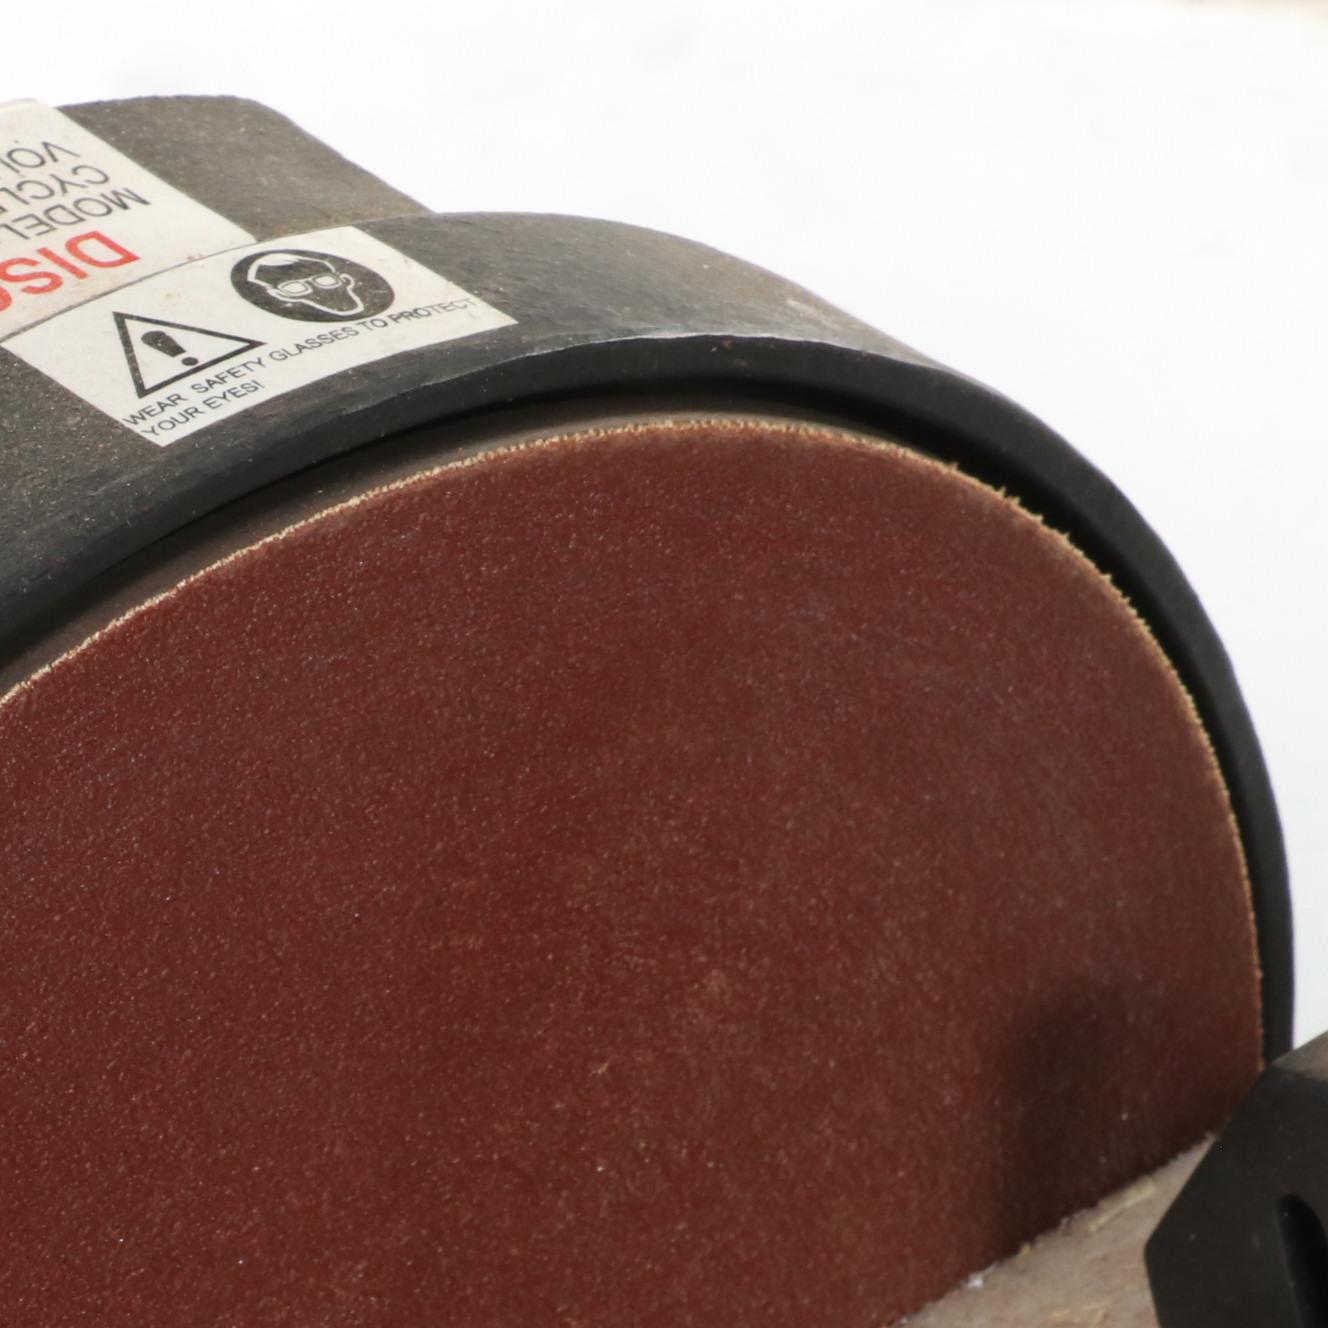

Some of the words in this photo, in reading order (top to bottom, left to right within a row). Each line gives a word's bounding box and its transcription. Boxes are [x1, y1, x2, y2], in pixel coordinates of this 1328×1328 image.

[122, 393, 187, 426] WEAR
[191, 357, 267, 394] SAFETY
[269, 326, 360, 362] GLASSES
[356, 317, 389, 332] TO
[387, 298, 478, 325] PROTECT
[140, 405, 207, 437] YOUR
